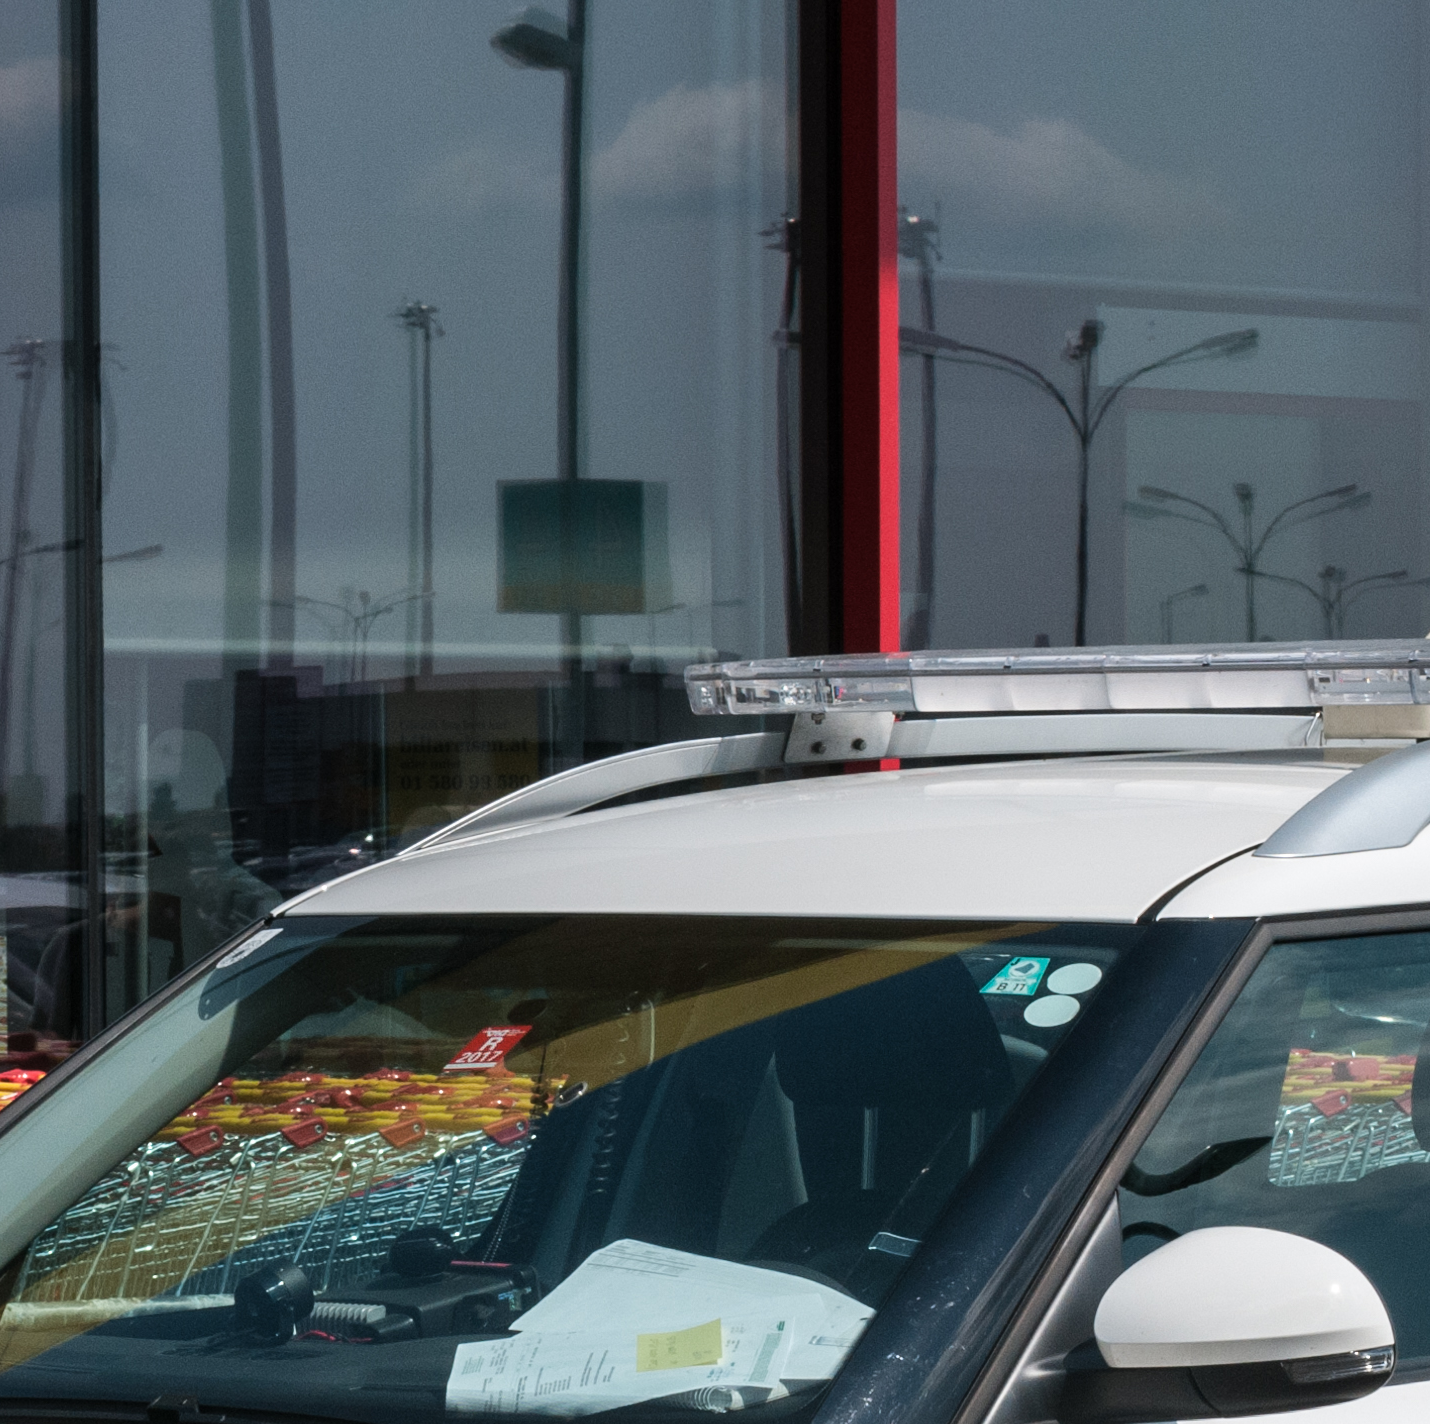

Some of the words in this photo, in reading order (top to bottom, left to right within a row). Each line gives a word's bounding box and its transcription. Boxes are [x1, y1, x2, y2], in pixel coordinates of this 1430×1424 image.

[400, 775, 422, 790] 01
[429, 774, 463, 790] 580
[478, 1036, 504, 1052] R
[455, 1050, 503, 1063] 2017
